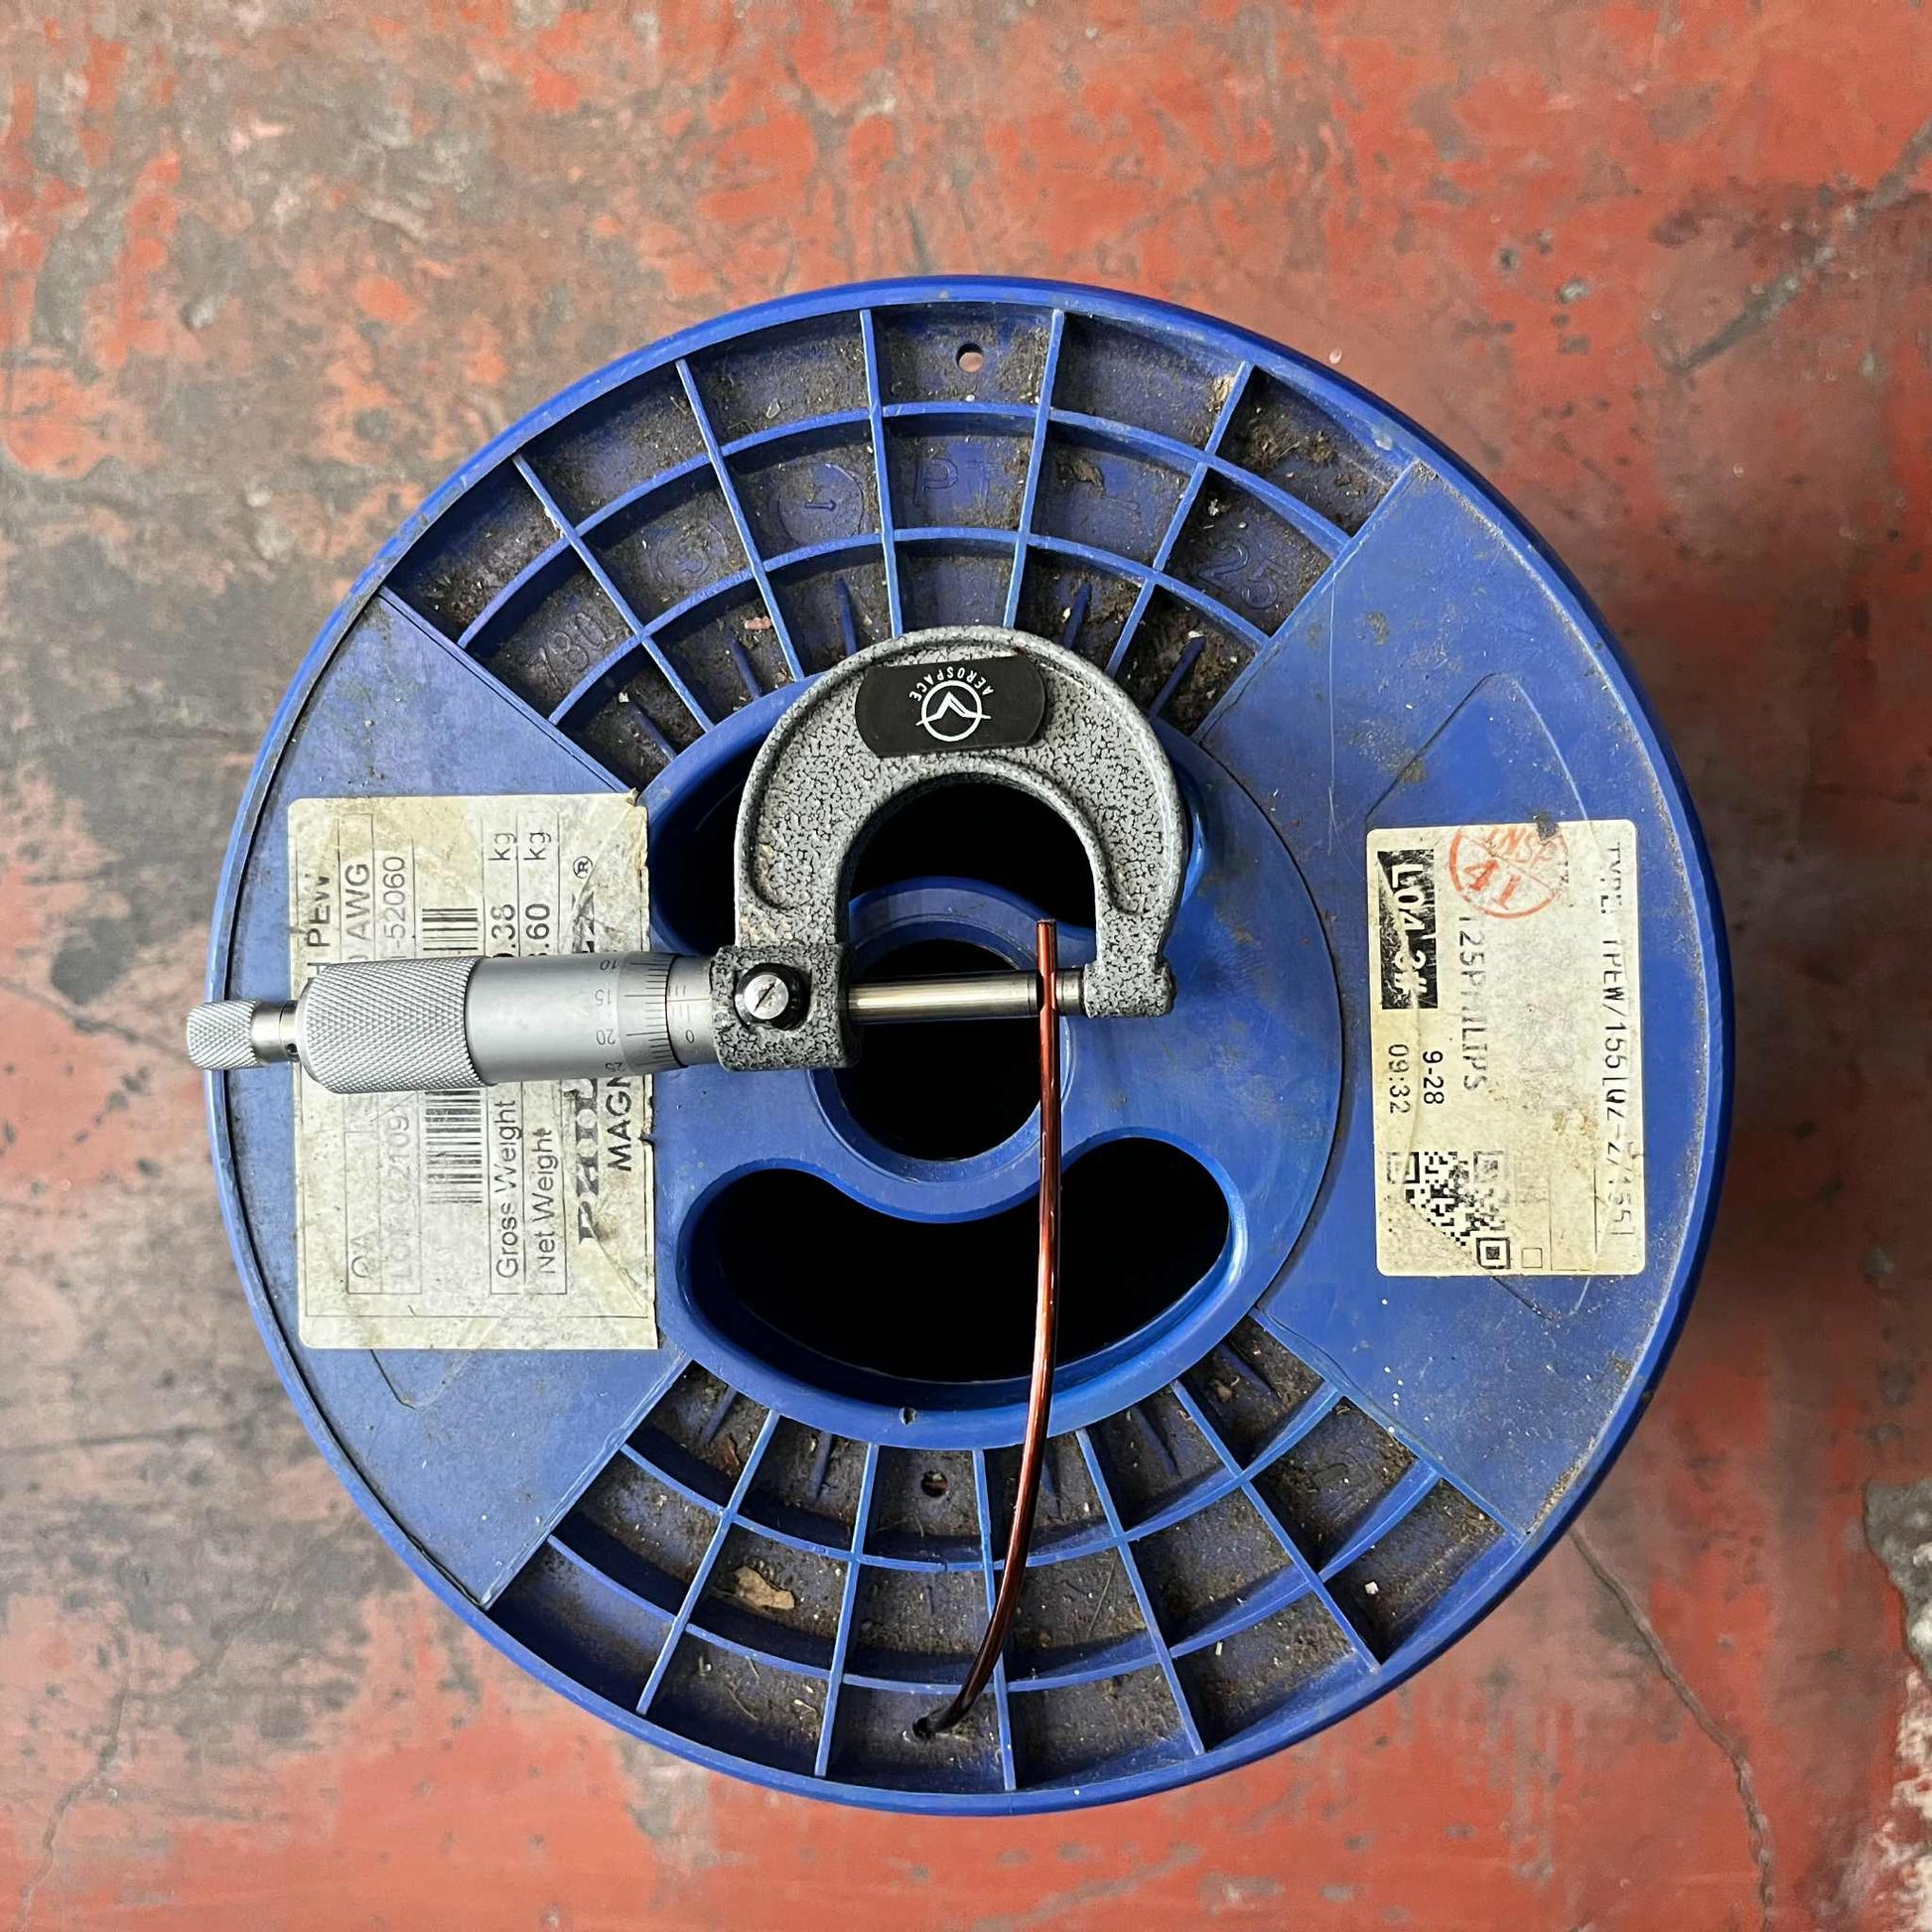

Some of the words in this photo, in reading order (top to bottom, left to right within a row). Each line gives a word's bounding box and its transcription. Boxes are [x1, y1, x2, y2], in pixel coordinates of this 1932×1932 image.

[908, 666, 994, 703] AEROSPACE
[487, 832, 517, 861] kg
[523, 832, 552, 861] kg
[345, 863, 371, 941] AWG
[1388, 1043, 1411, 1114] 09:32
[1422, 1050, 1445, 1105] 9-28
[494, 1099, 522, 1193] Weight
[531, 1127, 559, 1222] Weight
[495, 1202, 518, 1278] Gross
[535, 1230, 556, 1274] Net
